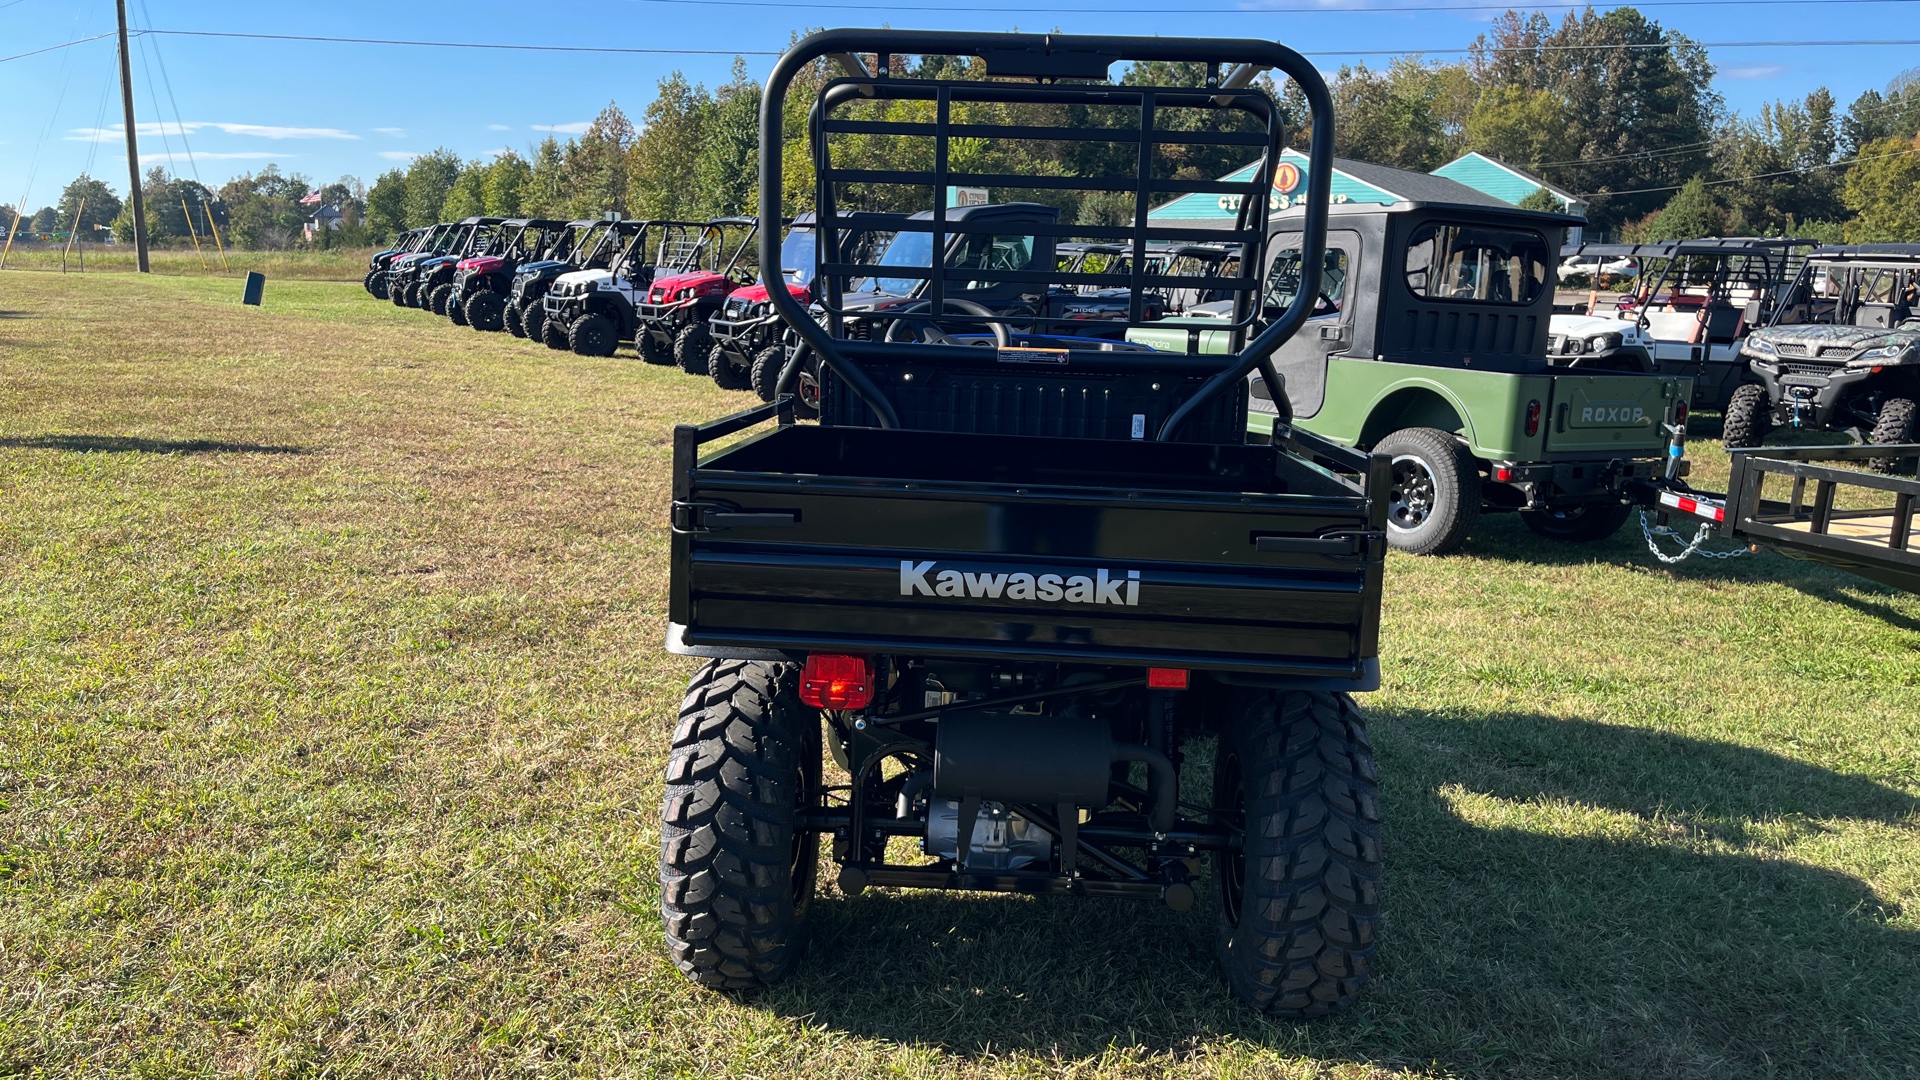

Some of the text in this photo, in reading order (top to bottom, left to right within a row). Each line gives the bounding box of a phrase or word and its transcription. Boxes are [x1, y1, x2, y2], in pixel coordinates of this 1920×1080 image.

[1218, 193, 1347, 210] CYSS HP
[1581, 407, 1643, 422] ROXOR
[900, 560, 1141, 606] Kawasaki
